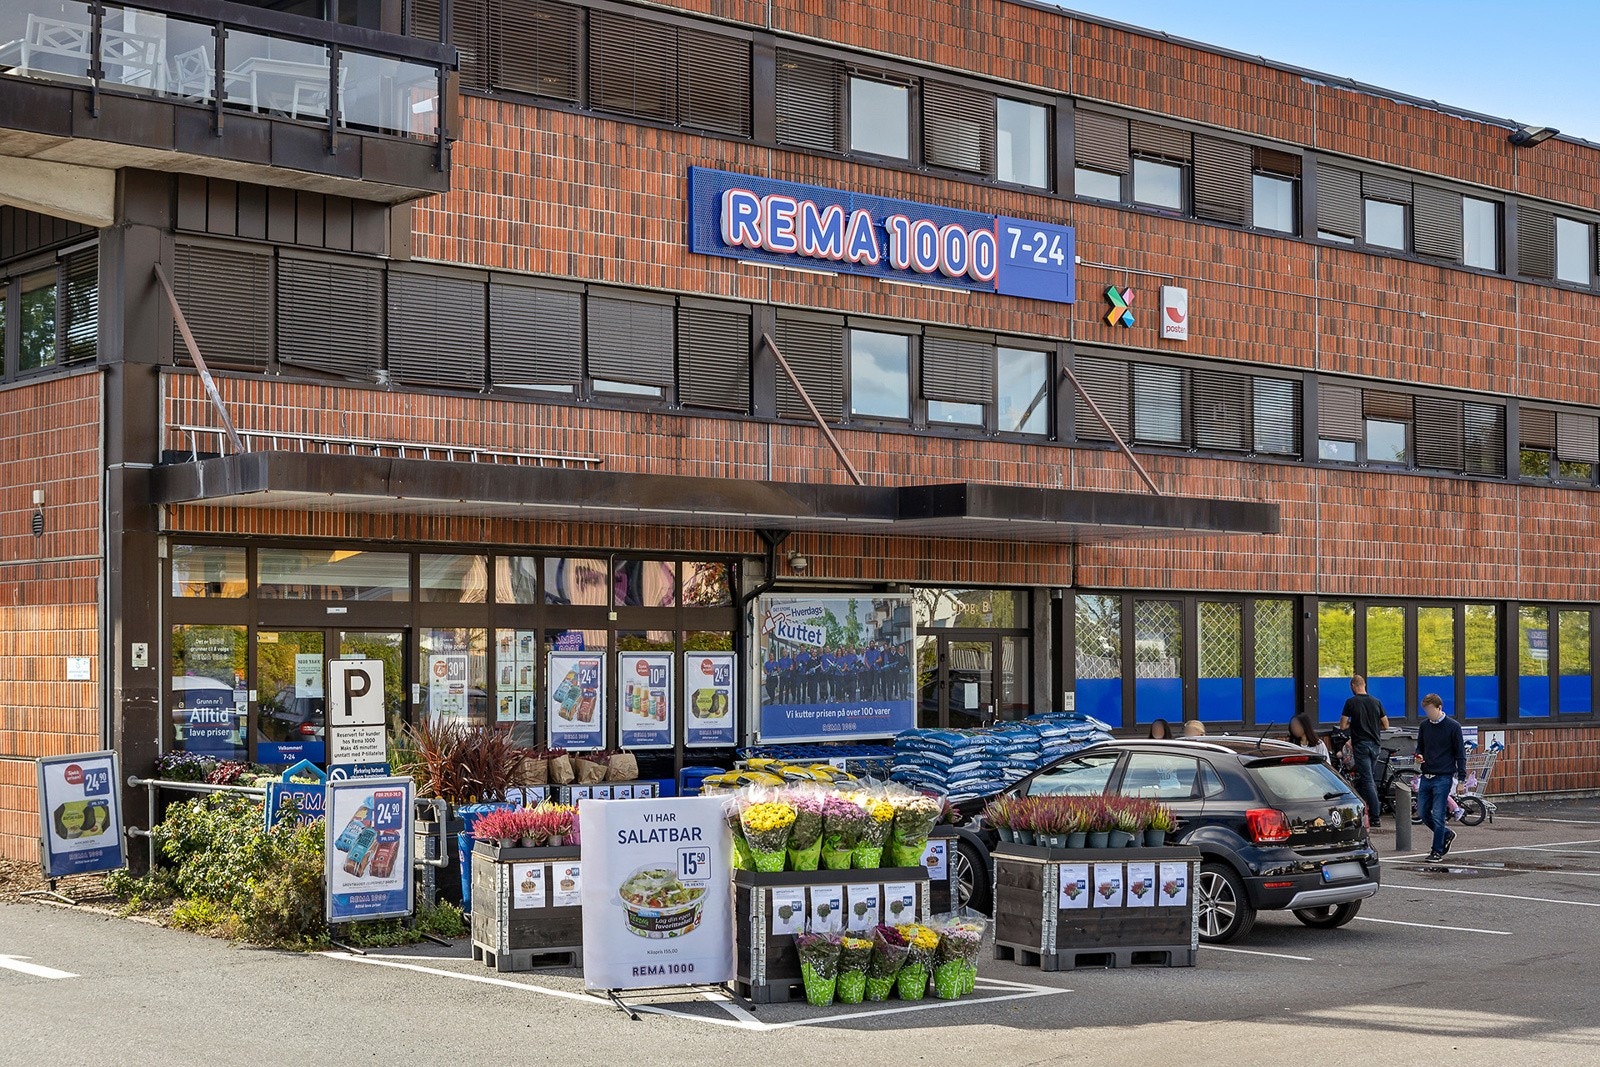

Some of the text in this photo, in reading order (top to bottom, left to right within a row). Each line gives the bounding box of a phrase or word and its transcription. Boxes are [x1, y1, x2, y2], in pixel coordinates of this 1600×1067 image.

[721, 188, 998, 283] REMA 1000
[1007, 227, 1065, 267] 7-24
[791, 606, 823, 617] Hverdags
[982, 601, 989, 613] B
[778, 621, 822, 645] kuttet
[448, 662, 459, 676] 30
[581, 670, 592, 684] 24
[650, 668, 659, 684] 10
[714, 668, 724, 683] 24
[344, 669, 371, 716] P
[190, 707, 229, 723] Alltid
[786, 707, 891, 719] Vi kutter prisen på over 100 varer
[189, 728, 230, 737] lave priser
[85, 773, 107, 792] 24 90
[279, 791, 327, 810] REM
[377, 803, 400, 824] 24 90
[643, 813, 676, 822] VI HAR
[618, 827, 702, 844] SALATBAR
[682, 852, 706, 875] 15 50
[632, 963, 695, 977] REMA 1000
